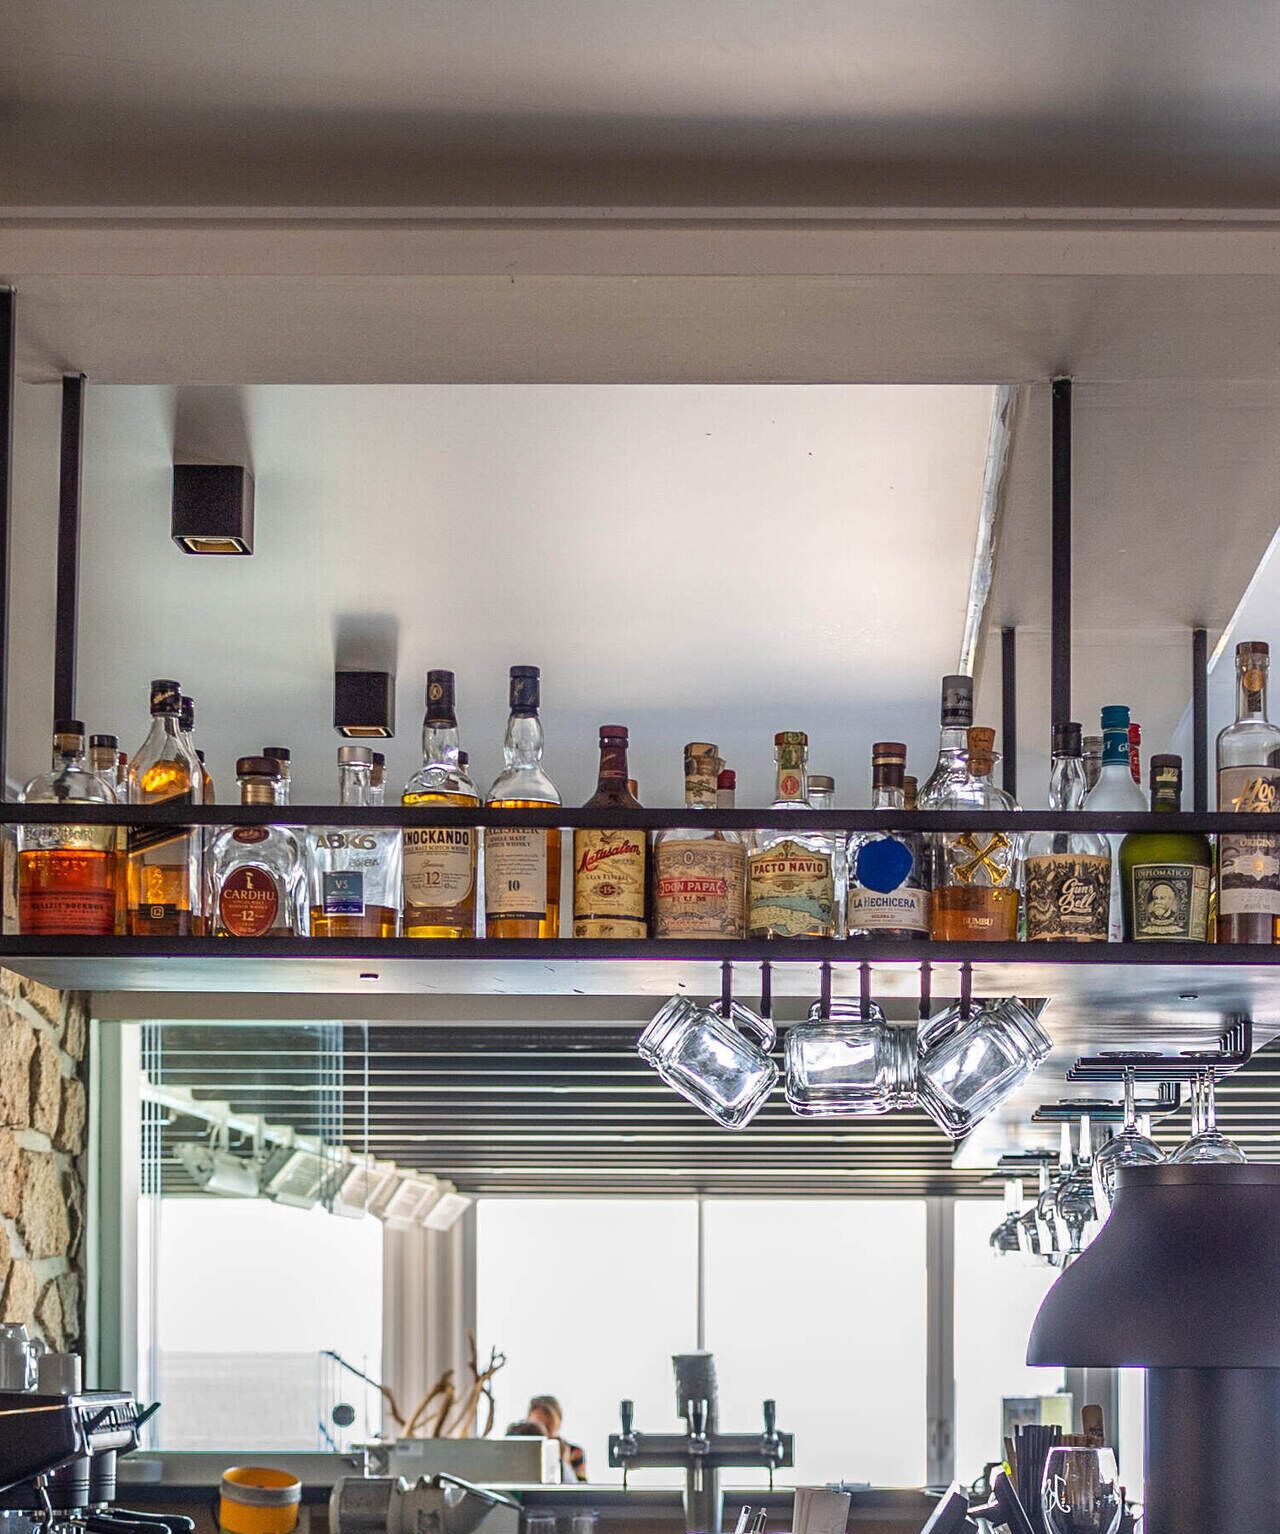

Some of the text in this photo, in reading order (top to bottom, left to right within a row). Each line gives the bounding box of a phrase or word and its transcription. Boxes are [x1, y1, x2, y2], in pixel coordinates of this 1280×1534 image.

[315, 833, 377, 850] ABK6
[753, 861, 824, 874] PACTO NAVIO
[425, 871, 440, 885] 12
[508, 879, 520, 891] 10
[665, 880, 716, 893] DON PAPA
[223, 889, 275, 901] CARDHU
[854, 896, 916, 909] LA HECHICERA
[240, 910, 254, 922] 12
